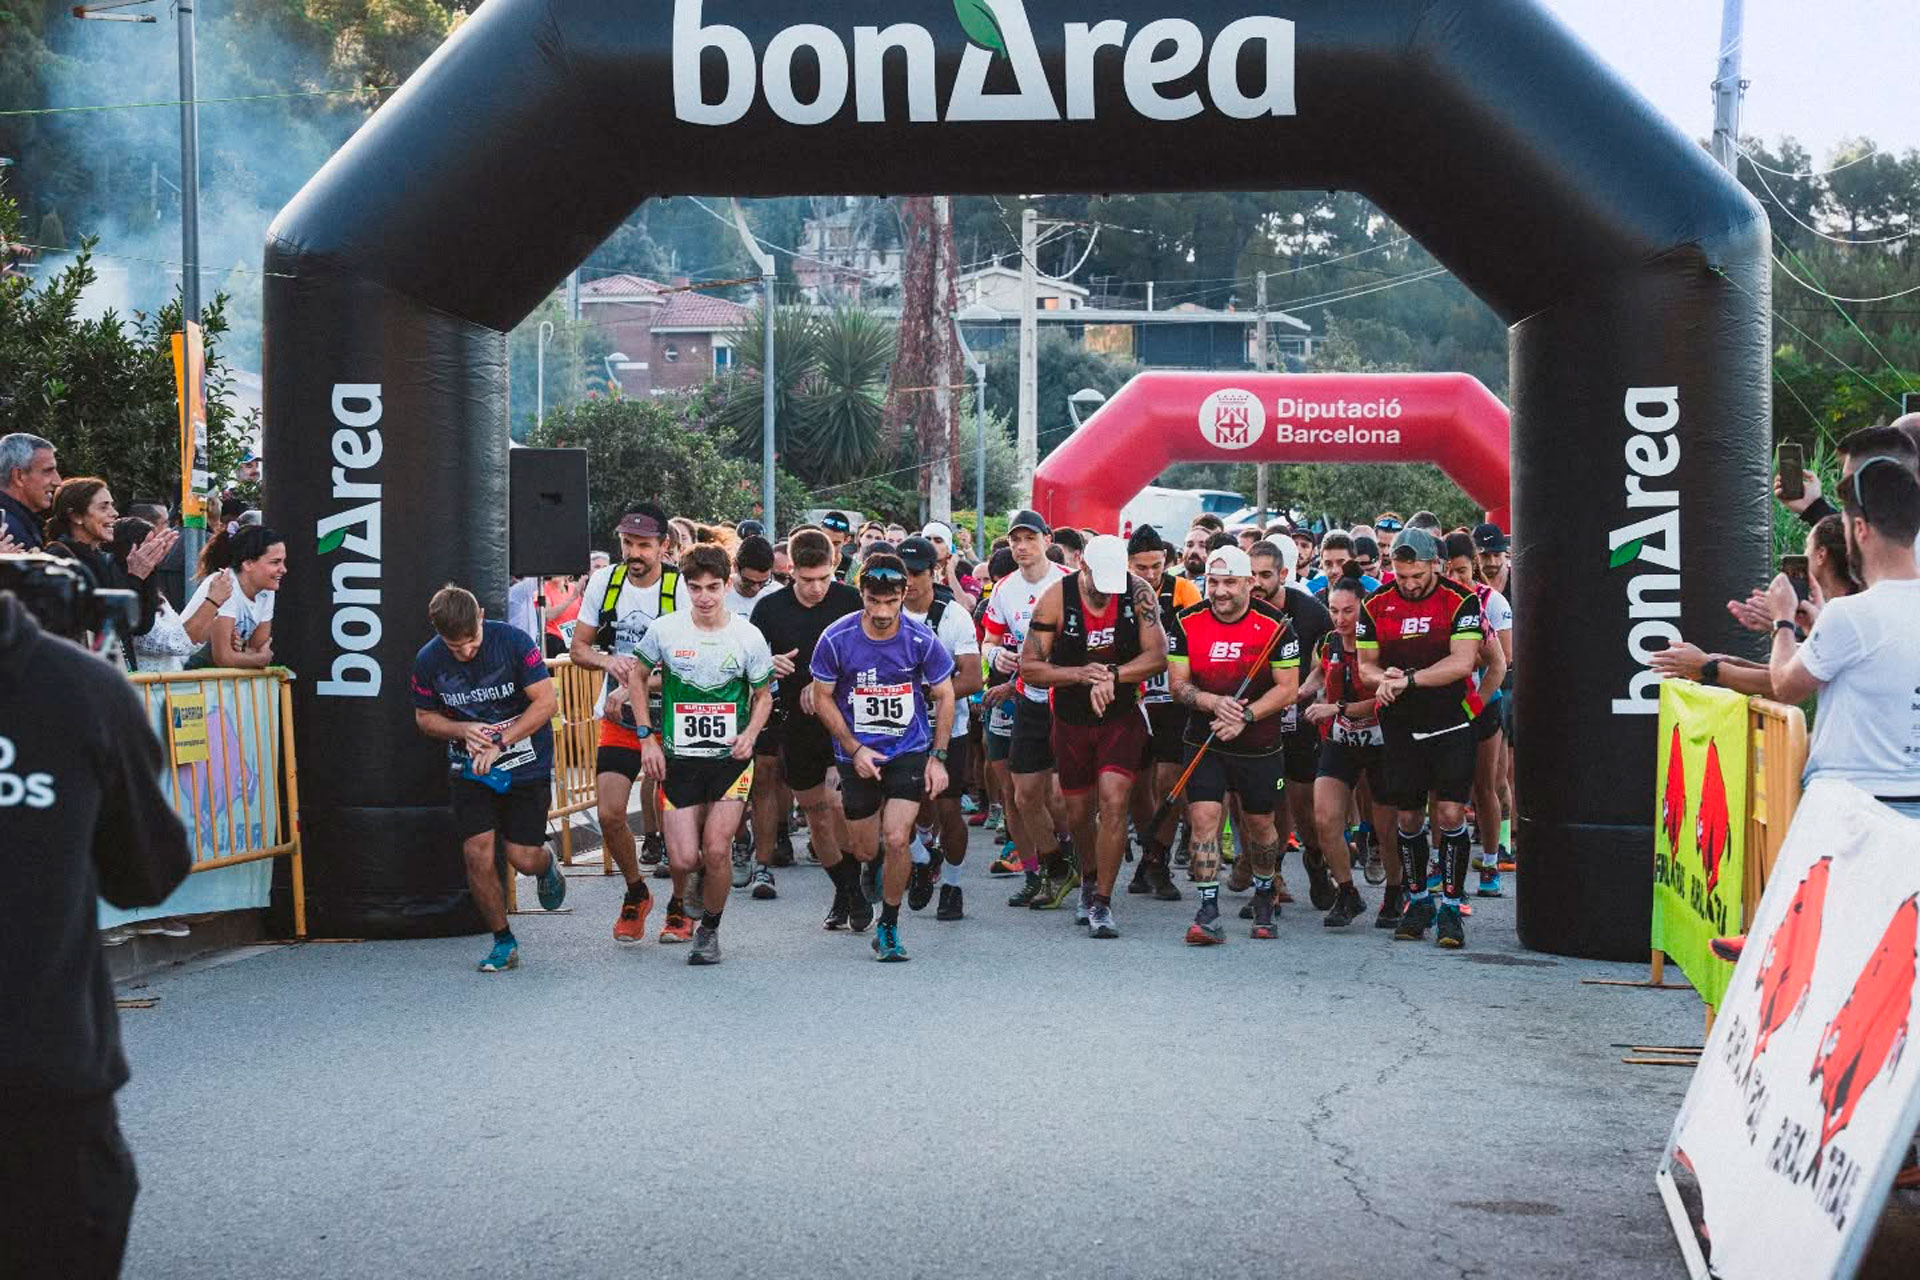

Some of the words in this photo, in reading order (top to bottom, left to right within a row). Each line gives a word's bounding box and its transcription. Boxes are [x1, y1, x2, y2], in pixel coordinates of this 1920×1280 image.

[673, 0, 1297, 125] bonArea
[1277, 397, 1403, 422] Diputació
[1276, 424, 1401, 444] Barcelona
[316, 383, 383, 697] bonArea
[866, 697, 903, 719] 315
[684, 716, 726, 738] 365
